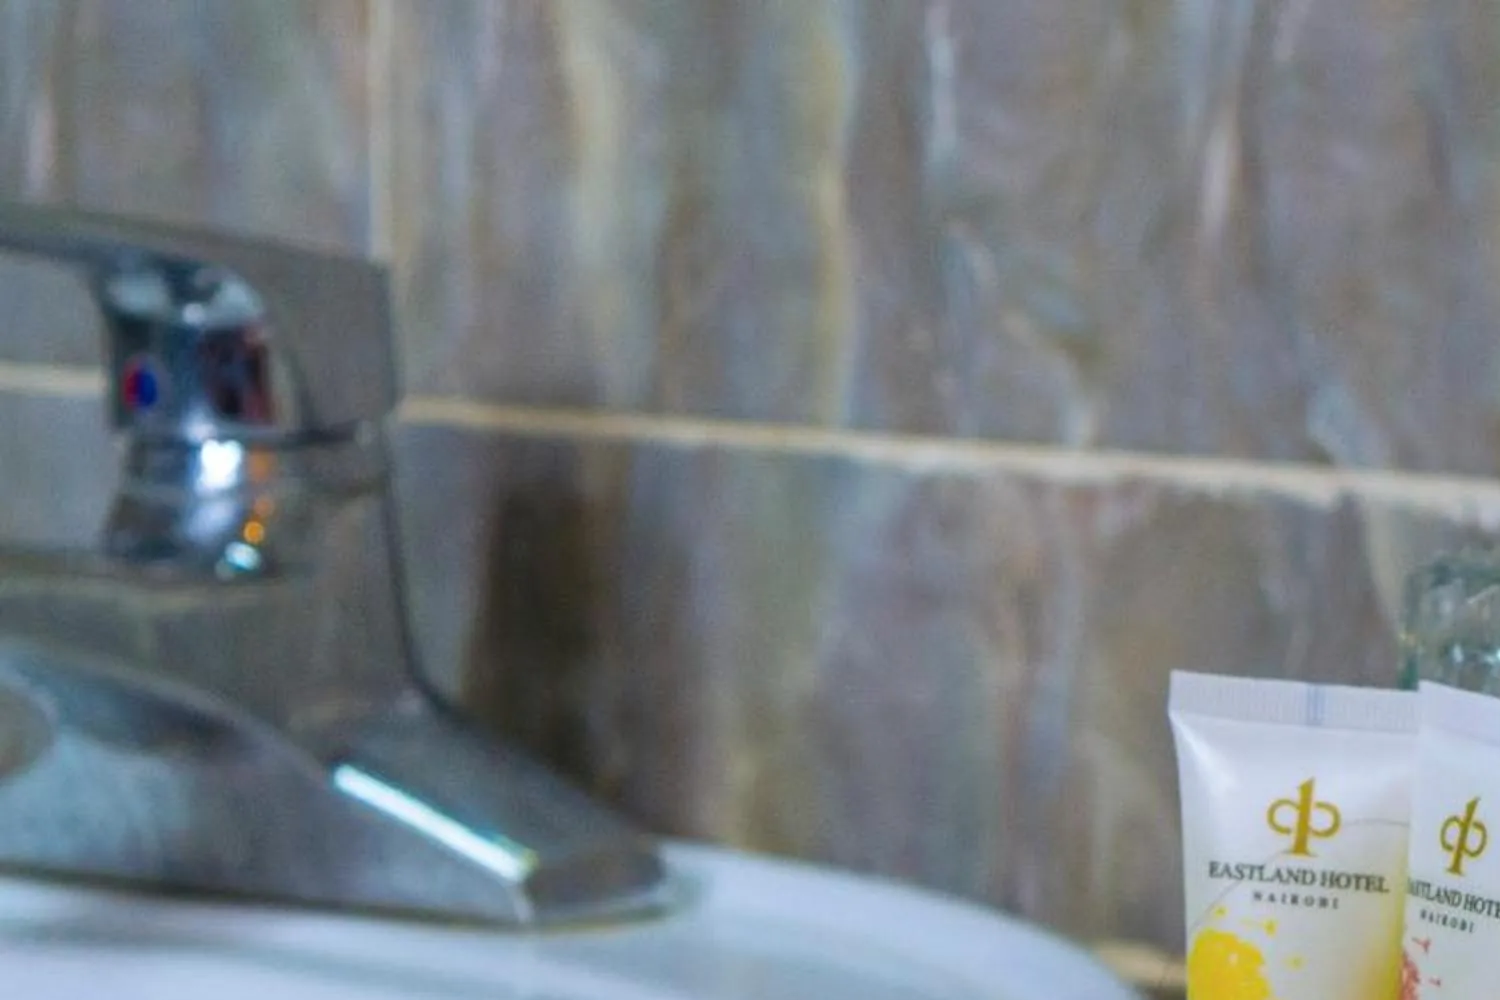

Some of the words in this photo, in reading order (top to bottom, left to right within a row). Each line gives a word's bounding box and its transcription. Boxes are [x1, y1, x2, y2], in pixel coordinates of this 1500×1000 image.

[1208, 861, 1316, 886] EASTLAND
[1319, 871, 1391, 893] HOTEL
[1253, 891, 1339, 910] NAIROBI
